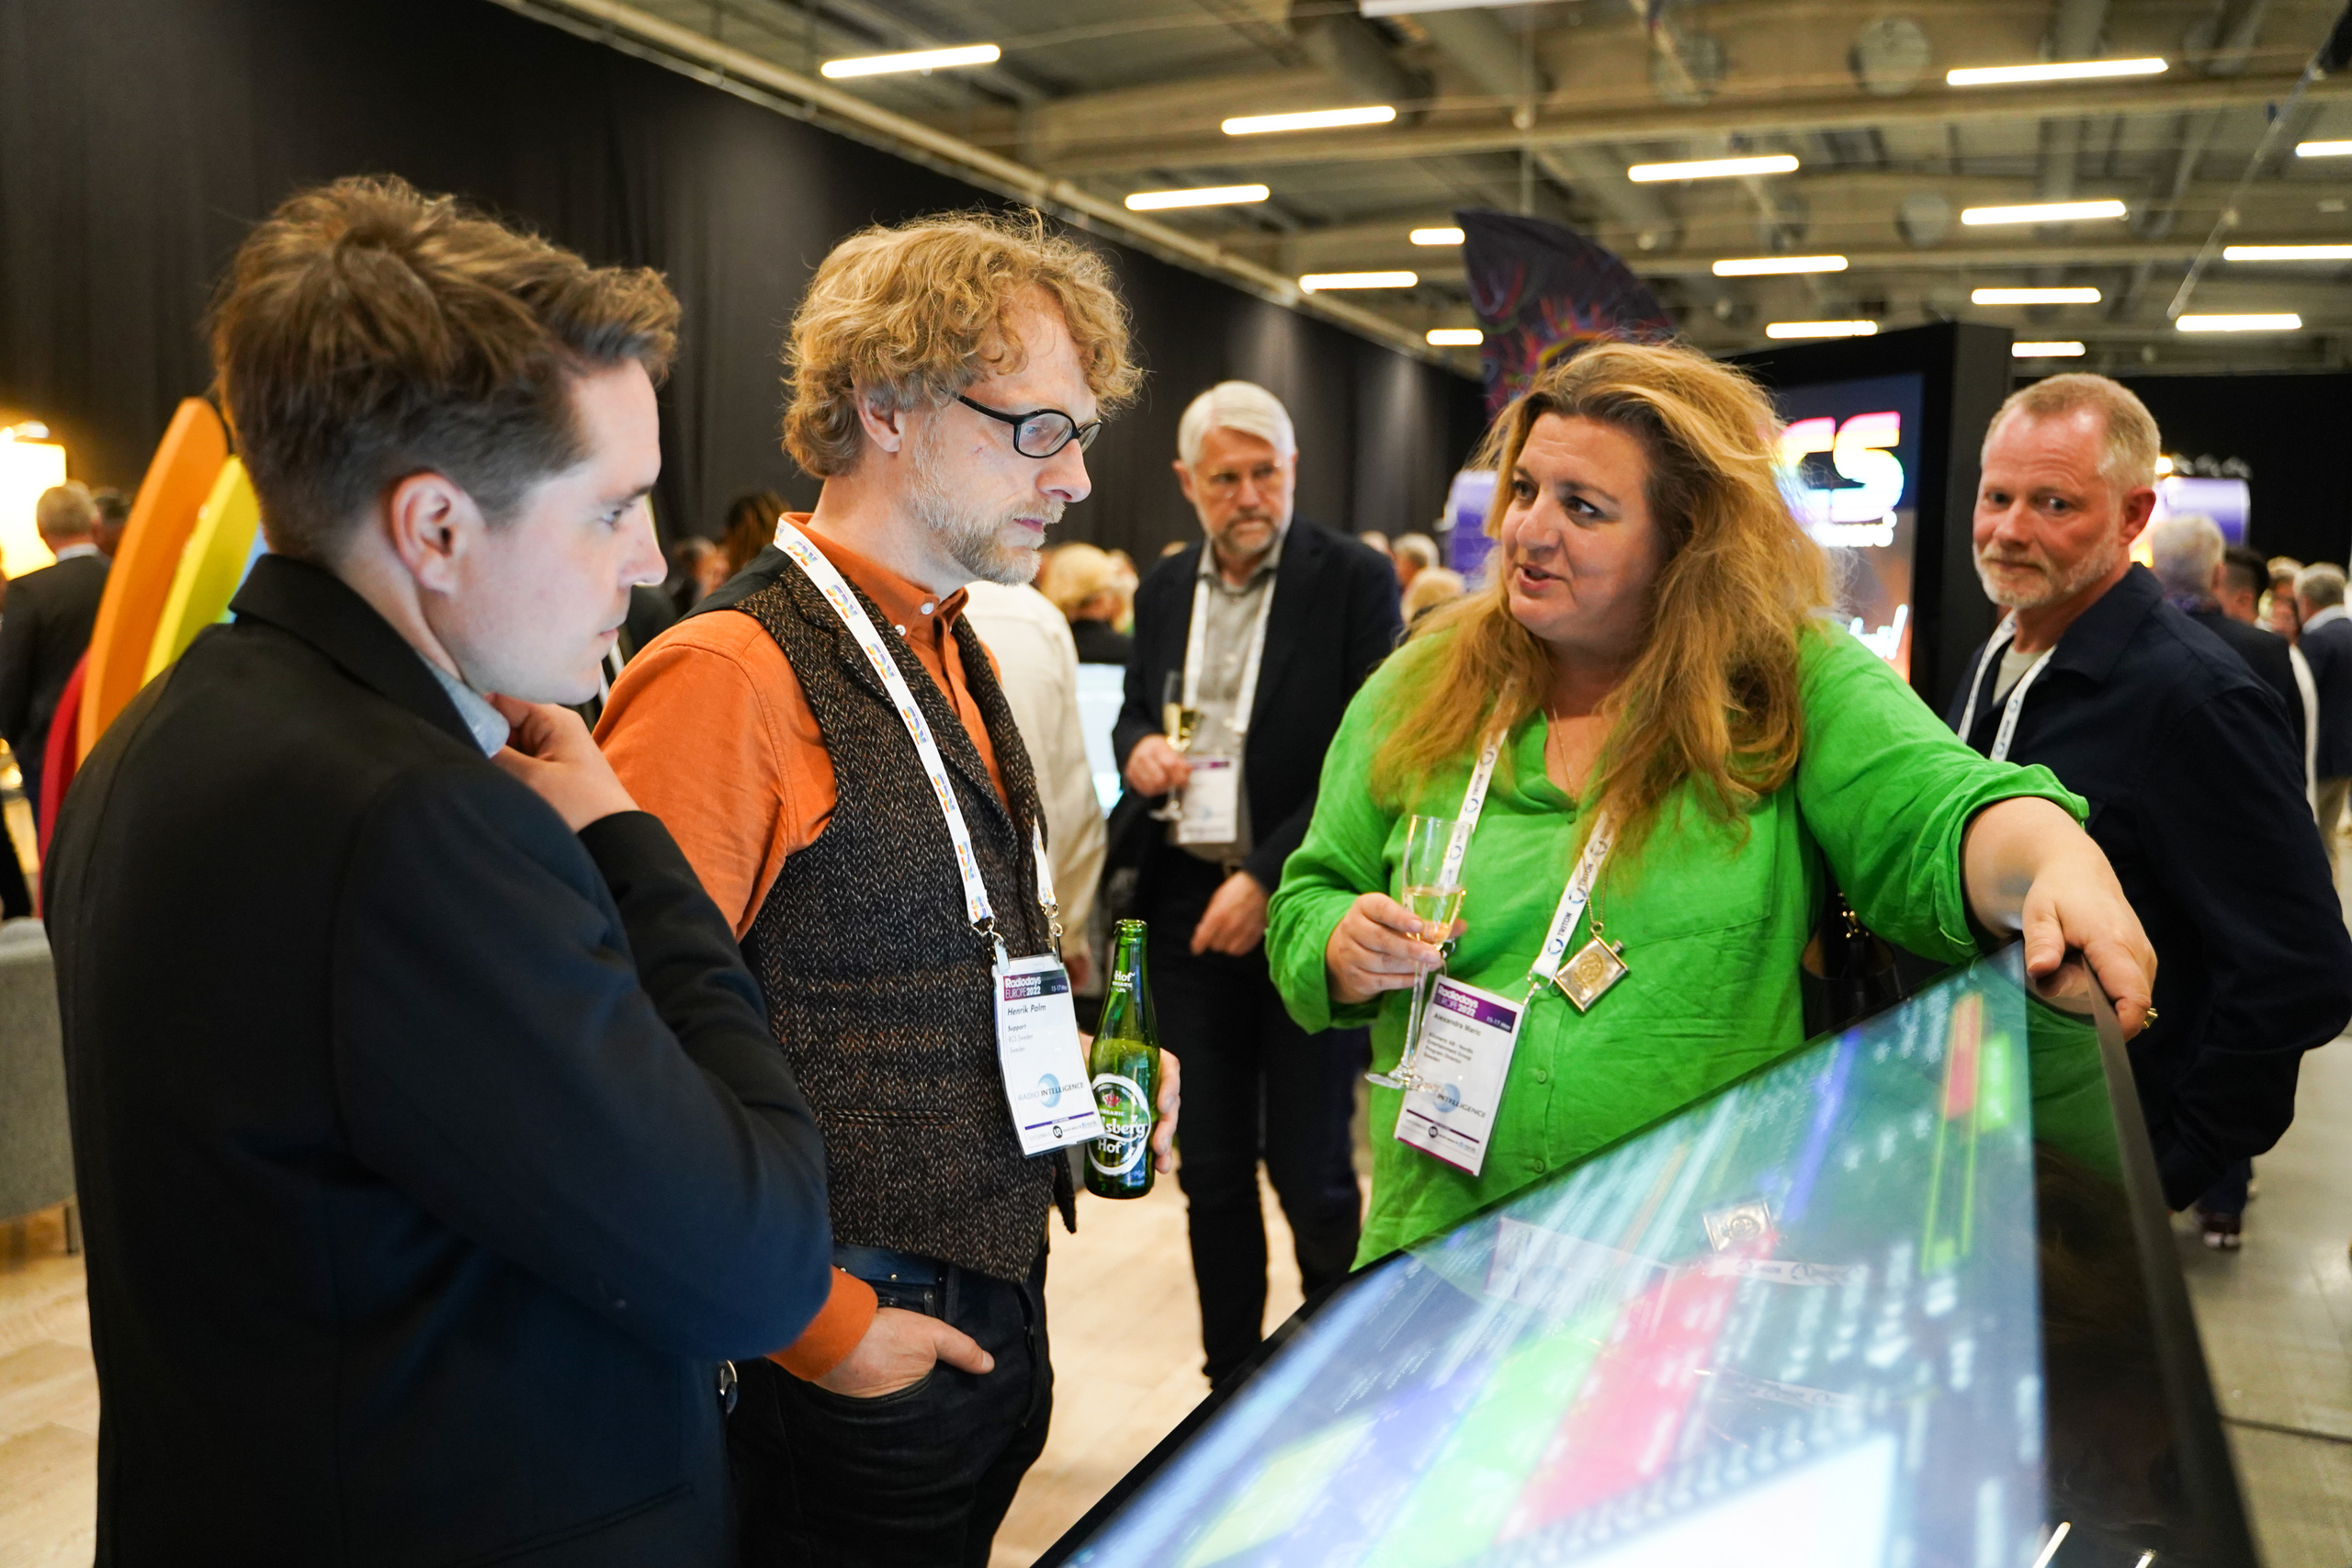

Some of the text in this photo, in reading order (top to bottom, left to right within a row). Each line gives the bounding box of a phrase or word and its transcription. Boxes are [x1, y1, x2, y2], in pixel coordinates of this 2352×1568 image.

[826, 584, 858, 619] RCS
[865, 643, 895, 680] RCS
[902, 705, 927, 746] RCS
[933, 773, 956, 813] RCS
[1579, 863, 1593, 886] TRITON
[1557, 912, 1572, 936] TRITON
[1005, 976, 1042, 988] Radiodays
[1114, 970, 1136, 982] Hof
[1438, 985, 1479, 1009] Radiodays
[1007, 1003, 1046, 1016] Henrik Palm
[1018, 1091, 1040, 1101] RADIO
[1041, 1082, 1084, 1097] INTELLIGENCE
[1437, 1094, 1486, 1118] INTELLIGENCE
[1098, 1139, 1126, 1154] Hof
